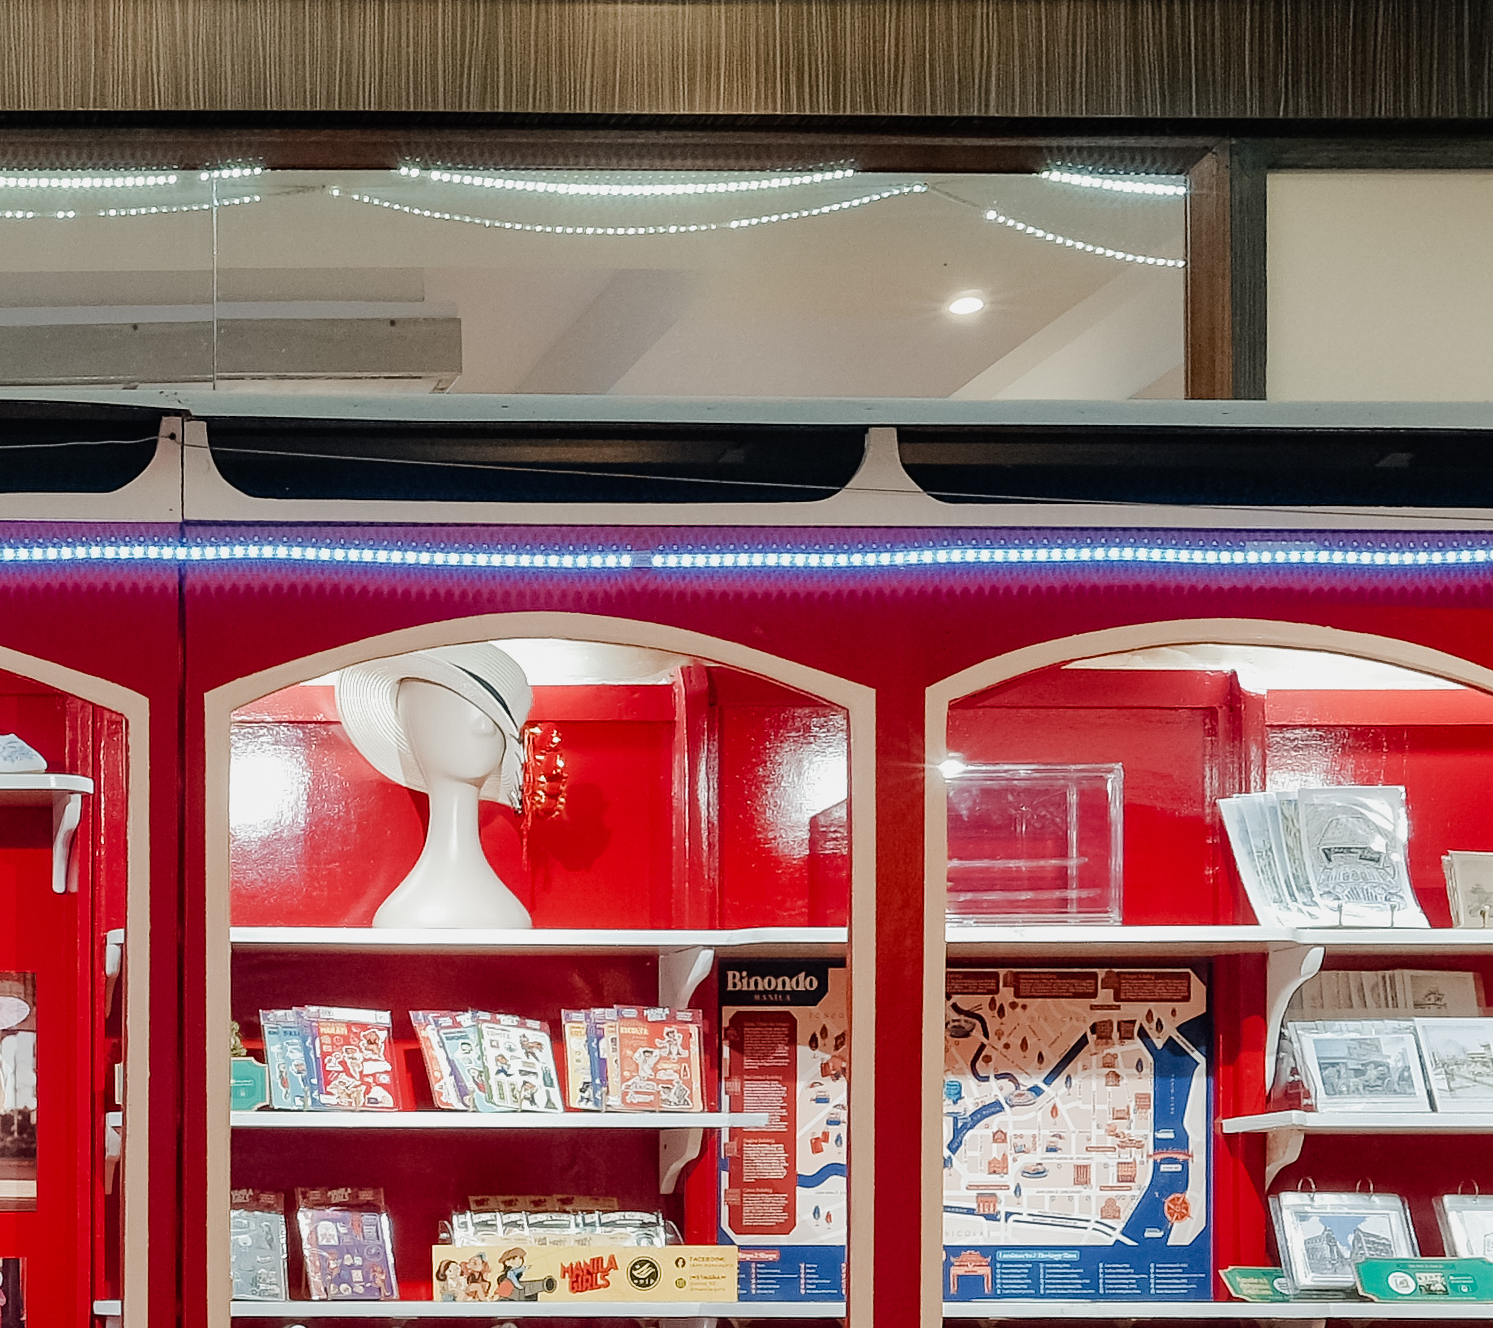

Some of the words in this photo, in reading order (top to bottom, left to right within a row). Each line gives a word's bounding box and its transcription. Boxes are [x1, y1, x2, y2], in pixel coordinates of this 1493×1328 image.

[726, 970, 819, 991] Binondo
[753, 993, 792, 1001] MANILA
[560, 1254, 619, 1279] MANILA
[568, 1271, 611, 1294] GIRLS
